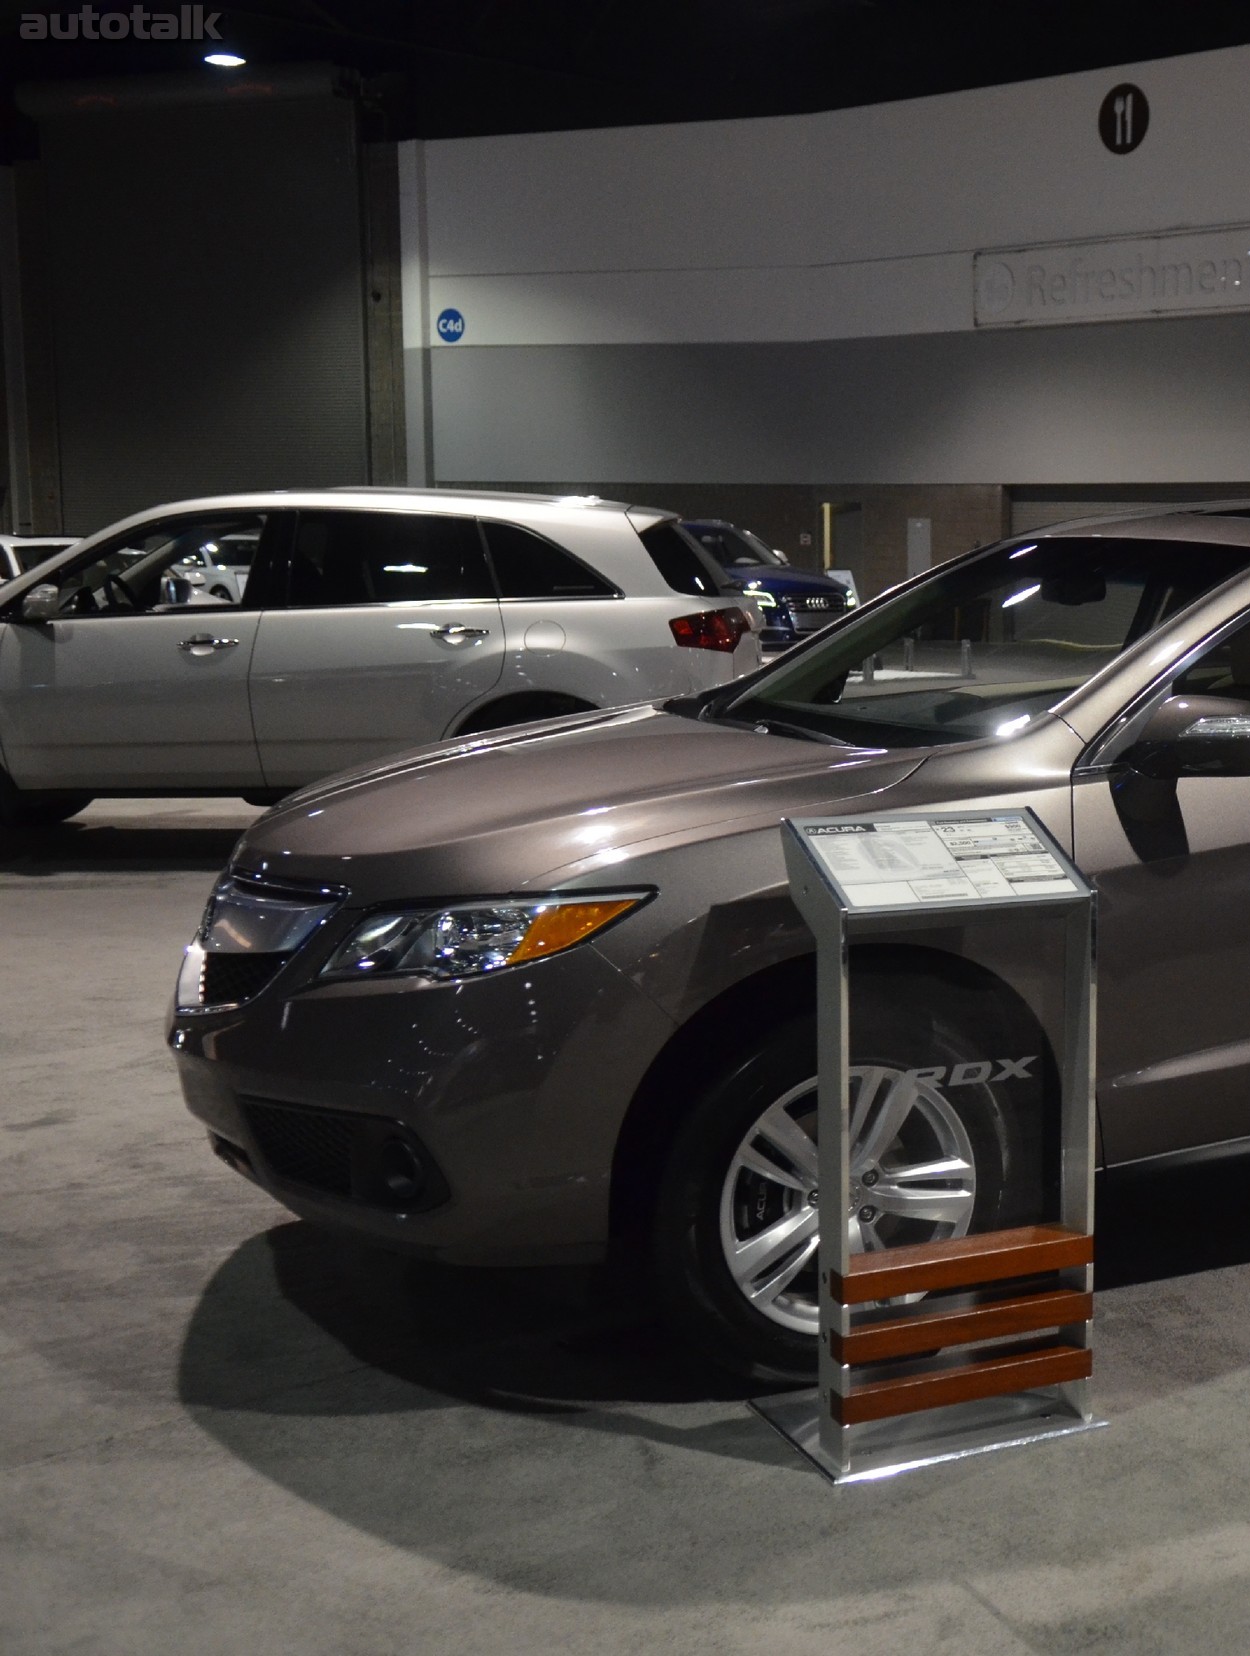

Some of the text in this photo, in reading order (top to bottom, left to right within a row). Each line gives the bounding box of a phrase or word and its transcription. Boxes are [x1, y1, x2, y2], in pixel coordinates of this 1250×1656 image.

[439, 318, 463, 333] C4d
[817, 825, 867, 834] ACURA
[903, 1055, 1039, 1090] RDX
